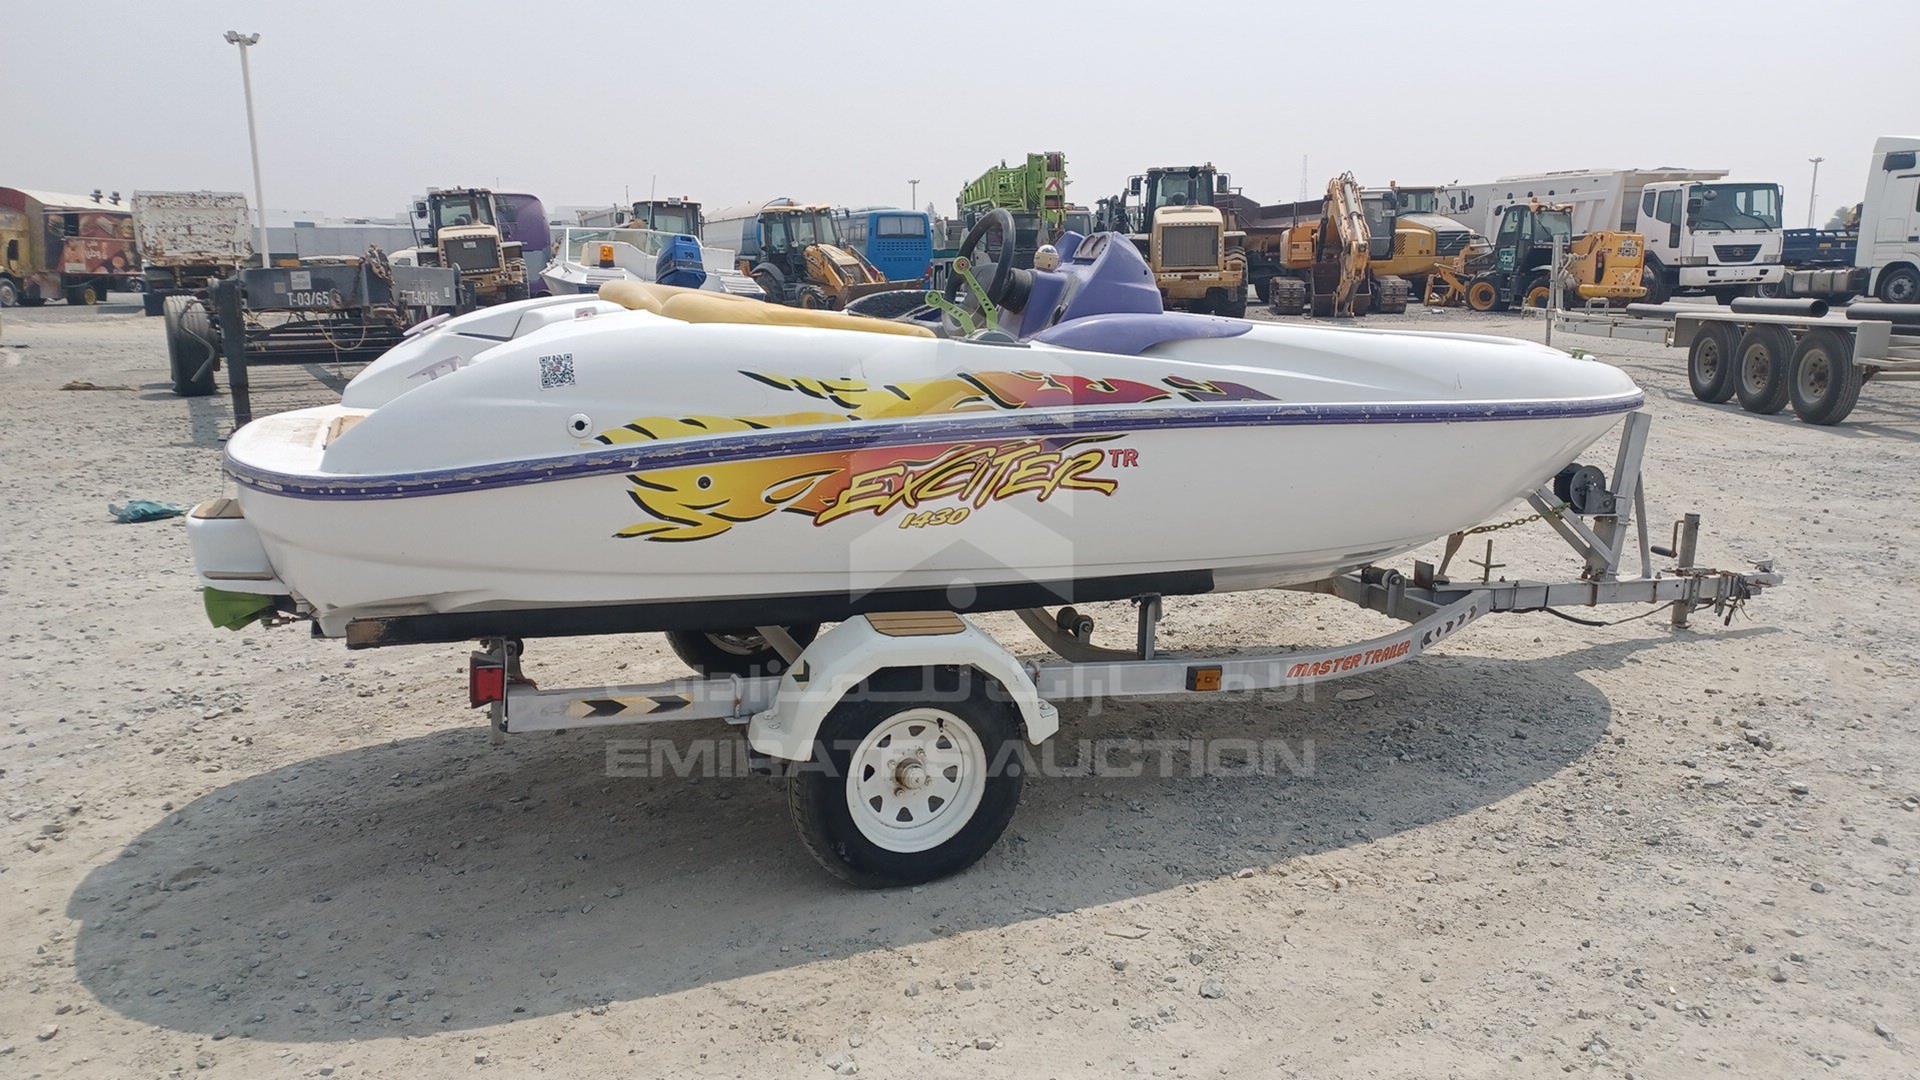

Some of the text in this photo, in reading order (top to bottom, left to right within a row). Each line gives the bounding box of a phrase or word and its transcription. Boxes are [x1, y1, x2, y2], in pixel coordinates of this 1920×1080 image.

[286, 291, 330, 306] T-03/65
[814, 443, 1138, 527] EXCITER TR
[899, 508, 970, 529] 1430
[1286, 639, 1412, 678] MASTER TRAILER
